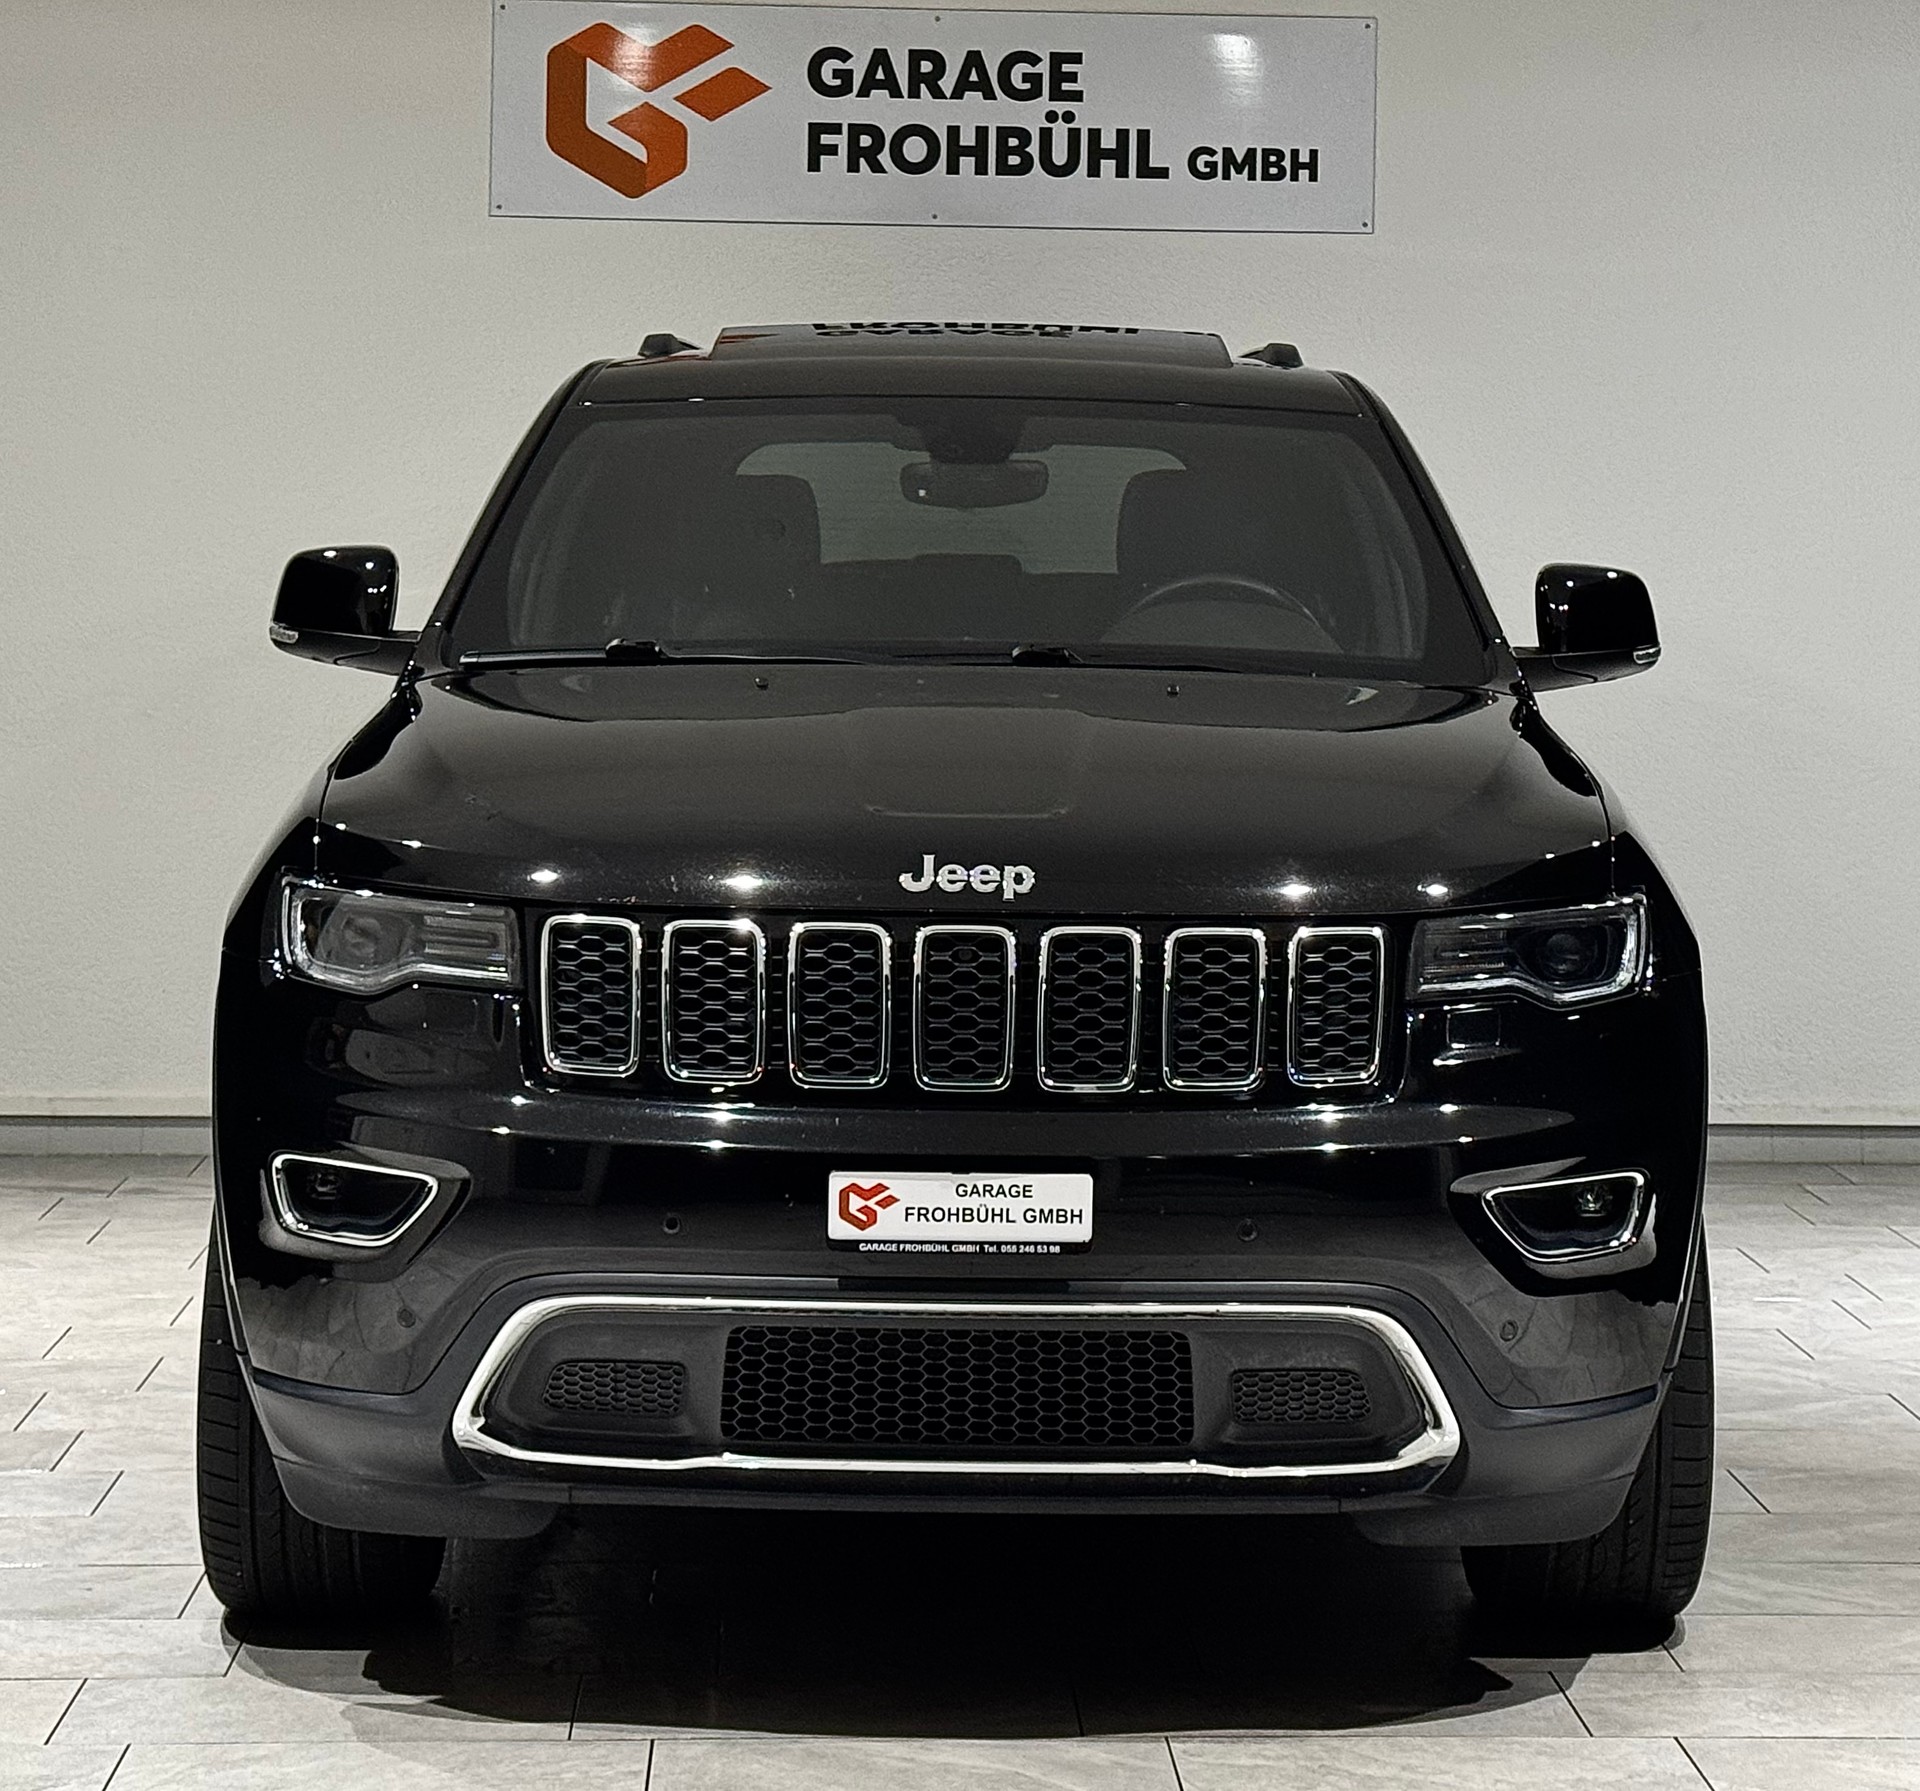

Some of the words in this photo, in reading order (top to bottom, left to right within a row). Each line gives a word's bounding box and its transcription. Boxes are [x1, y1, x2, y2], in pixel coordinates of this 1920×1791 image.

[806, 46, 1085, 103] GARAGE
[806, 109, 1171, 181] FROHBÜHL
[1186, 145, 1320, 183] GMBH
[898, 854, 1036, 901] Jeep
[954, 1183, 1034, 1199] GARAGE
[903, 1203, 1017, 1224] FROHBÜHL
[1022, 1207, 1083, 1225] GMBH
[858, 1242, 898, 1252] GARAGE
[899, 1242, 950, 1253] FROHBÜHL
[983, 1244, 999, 1253] Tel.
